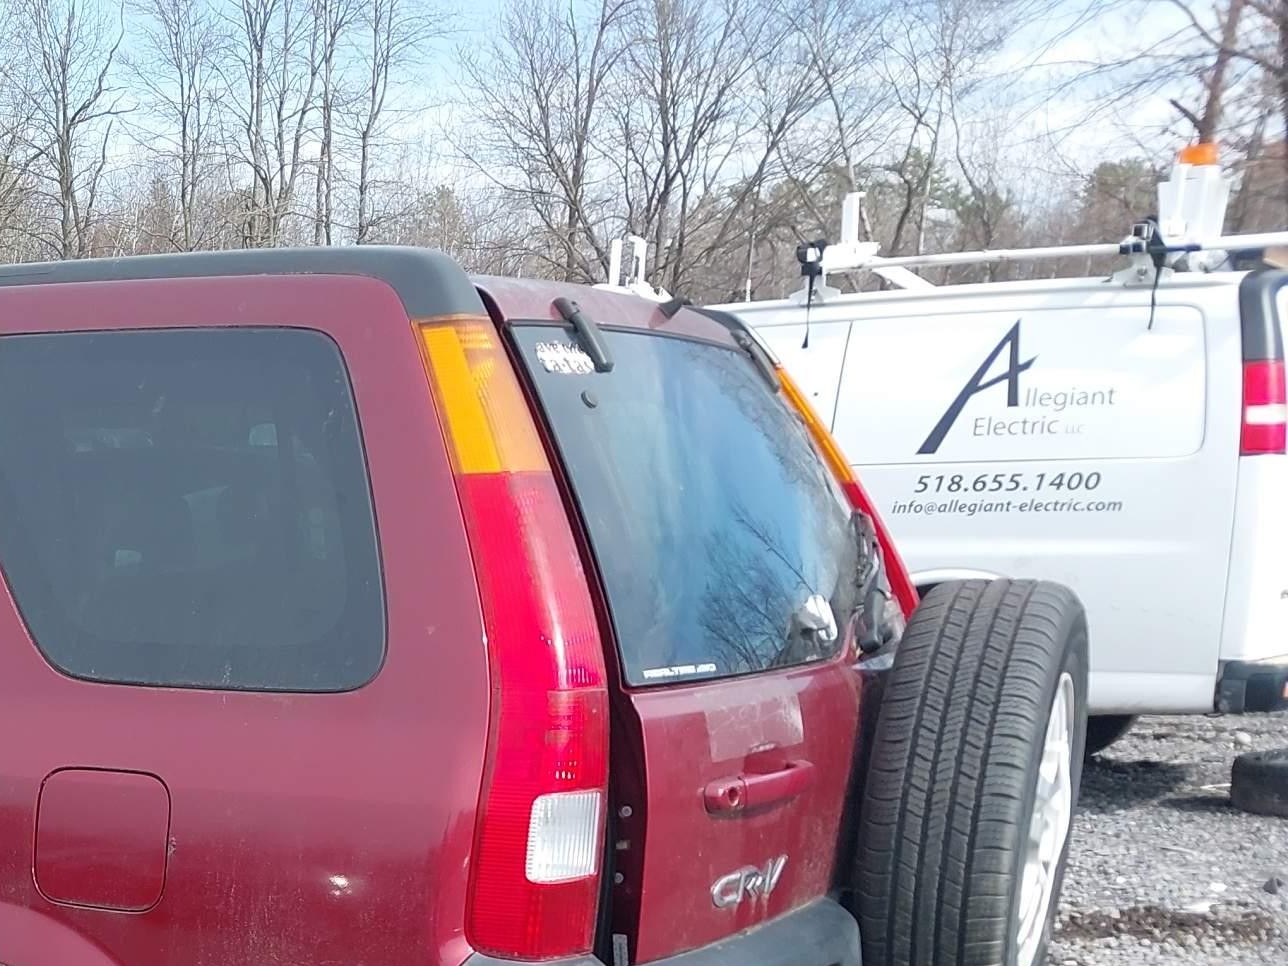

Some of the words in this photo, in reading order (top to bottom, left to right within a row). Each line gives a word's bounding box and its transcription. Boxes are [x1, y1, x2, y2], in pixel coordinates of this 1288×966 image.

[973, 415, 1059, 437] Electric
[1064, 424, 1084, 434] LLC
[914, 472, 1102, 493] 518.655.1400
[891, 499, 1122, 516] info@allegiant-electric.com
